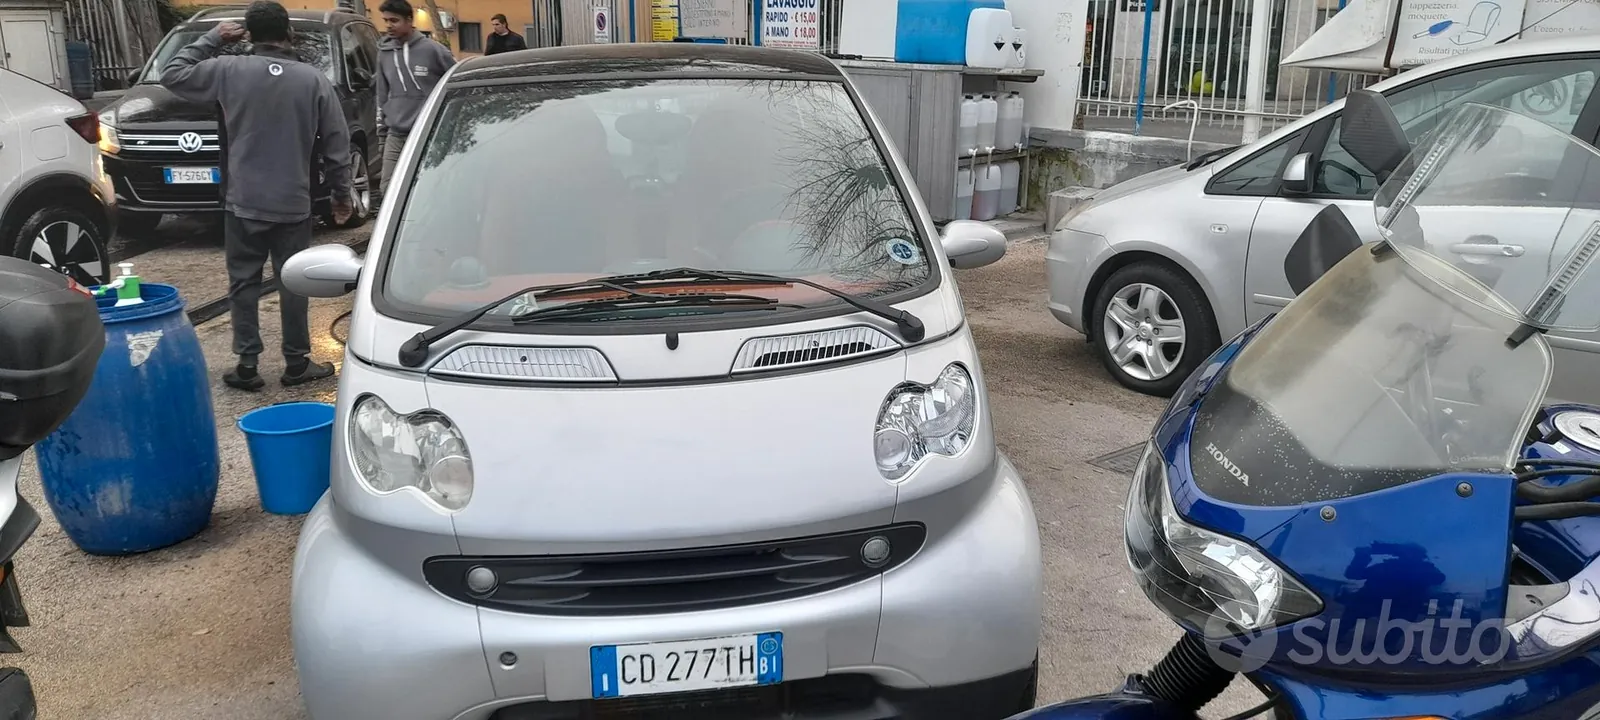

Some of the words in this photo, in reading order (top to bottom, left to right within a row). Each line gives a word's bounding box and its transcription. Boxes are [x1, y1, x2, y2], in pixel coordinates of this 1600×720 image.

[766, 12, 789, 22] RAPIDO
[795, 12, 799, 23] €
[800, 12, 816, 25] 15,00
[766, 27, 770, 36] A
[771, 27, 789, 37] MANO
[795, 27, 799, 37] €
[800, 27, 816, 40] 18,00
[1418, 47, 1450, 55] Risultati
[1205, 442, 1249, 487] HONDA
[621, 653, 655, 685] CD
[665, 645, 755, 682] 277TH
